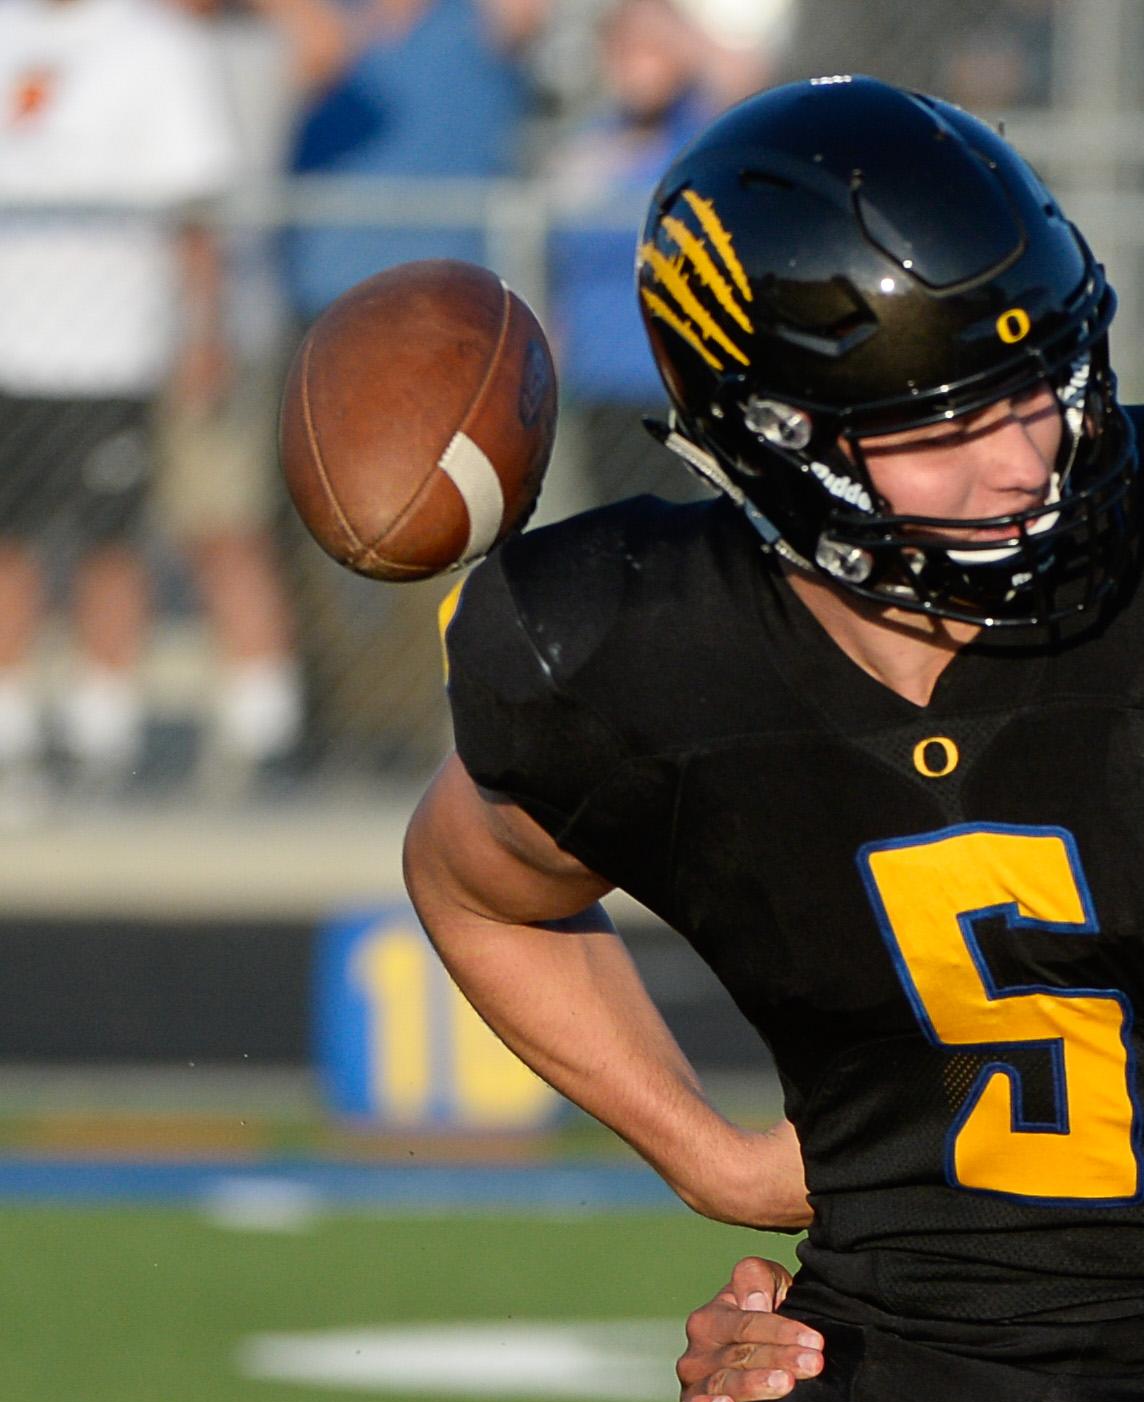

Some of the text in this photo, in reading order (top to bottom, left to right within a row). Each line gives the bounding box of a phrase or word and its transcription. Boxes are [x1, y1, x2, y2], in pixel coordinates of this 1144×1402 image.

[996, 308, 1030, 344] O
[810, 461, 874, 514] Ridde
[913, 736, 959, 778] O
